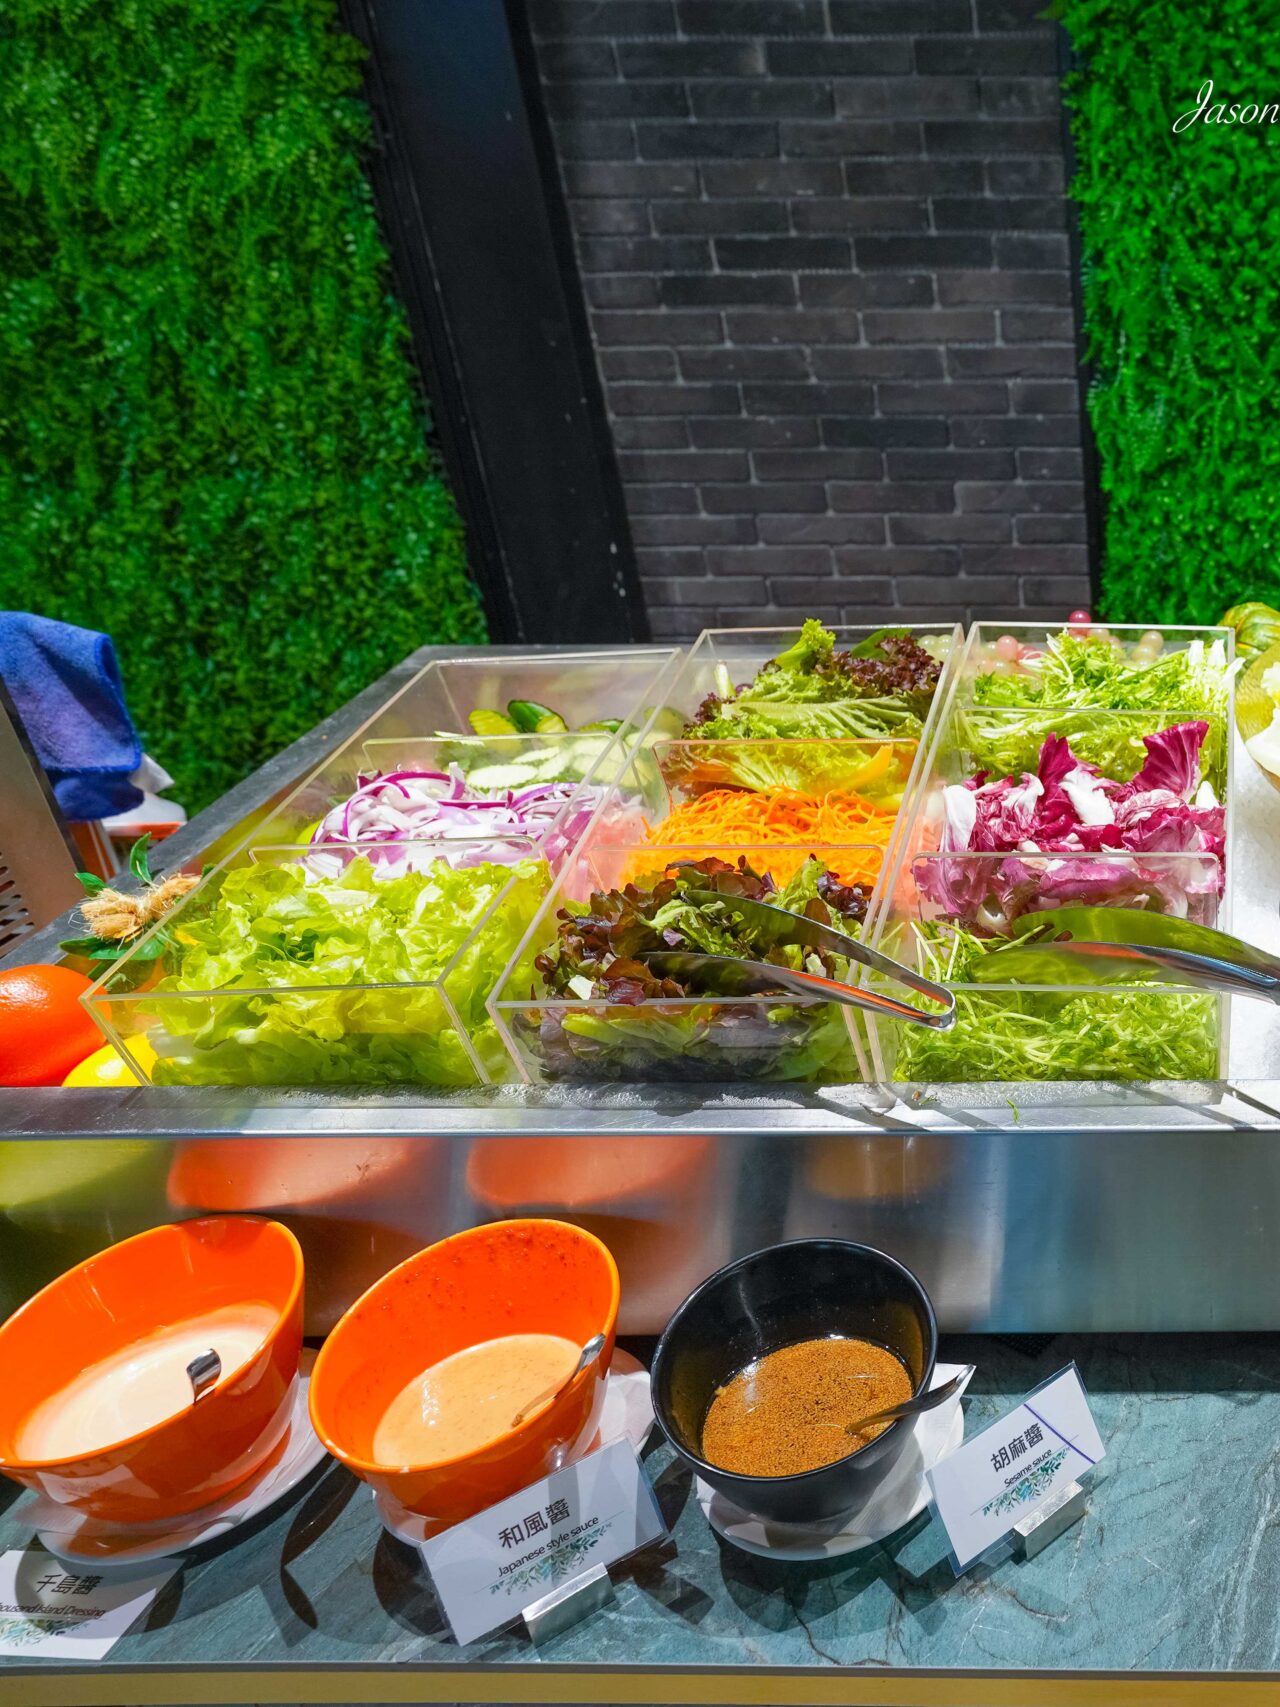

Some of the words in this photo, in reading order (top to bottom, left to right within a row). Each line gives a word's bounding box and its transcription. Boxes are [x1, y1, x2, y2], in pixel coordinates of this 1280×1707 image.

[990, 1422, 1044, 1473] 胡麻醬
[1004, 1464, 1033, 1488] Sesame
[1032, 1449, 1052, 1468] sauce
[498, 1498, 571, 1550] 和風醬
[498, 1546, 546, 1578] Japanese
[546, 1533, 570, 1551] style
[570, 1516, 600, 1538] sauce
[0, 1602, 36, 1614] ousand
